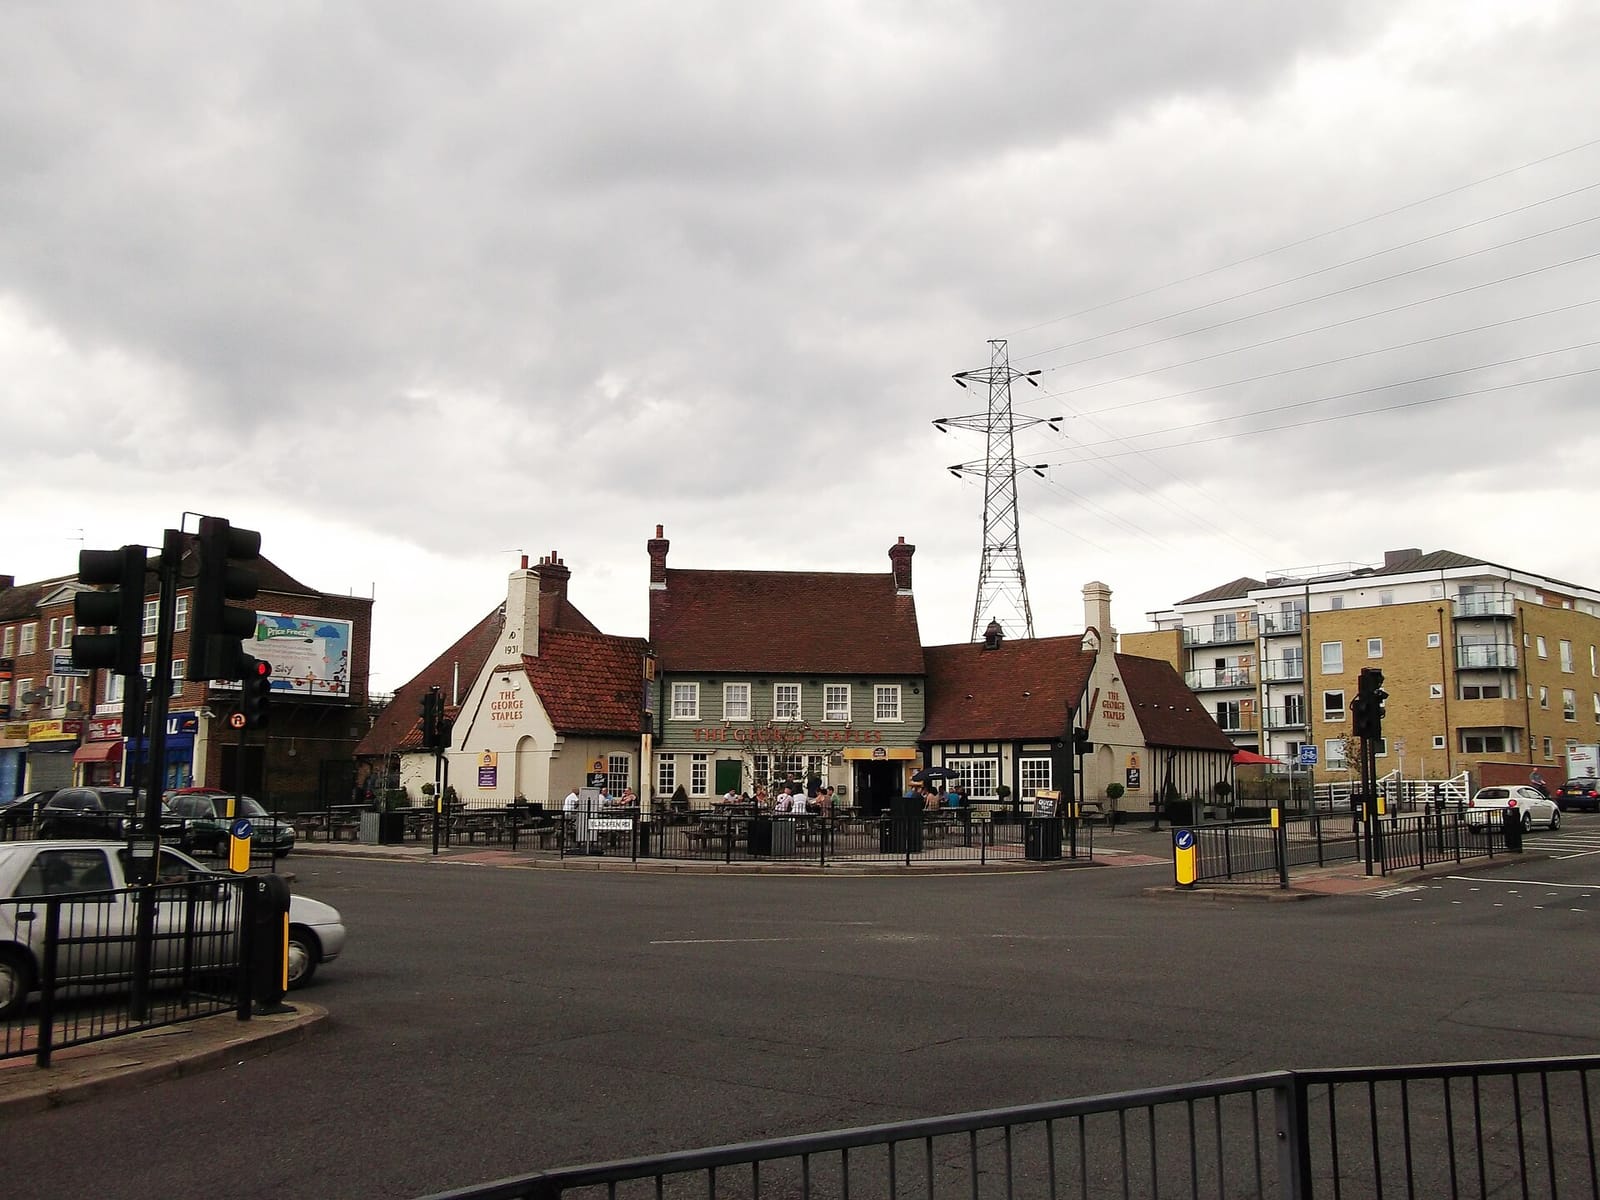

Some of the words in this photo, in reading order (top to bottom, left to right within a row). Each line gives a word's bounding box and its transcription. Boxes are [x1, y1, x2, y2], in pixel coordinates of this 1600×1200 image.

[267, 627, 285, 637] Price
[286, 628, 311, 637] Freeze
[504, 645, 520, 655] 1931
[274, 662, 295, 676] sky
[500, 691, 517, 700] THE
[1107, 691, 1120, 700] THE
[491, 700, 524, 711] GEORGE
[1102, 701, 1126, 711] GEORGE
[491, 711, 523, 721] STAPLES
[1102, 711, 1126, 721] STAPLES
[692, 728, 727, 742] THE
[733, 729, 805, 743] GEORGE
[812, 729, 882, 743] STAPLES
